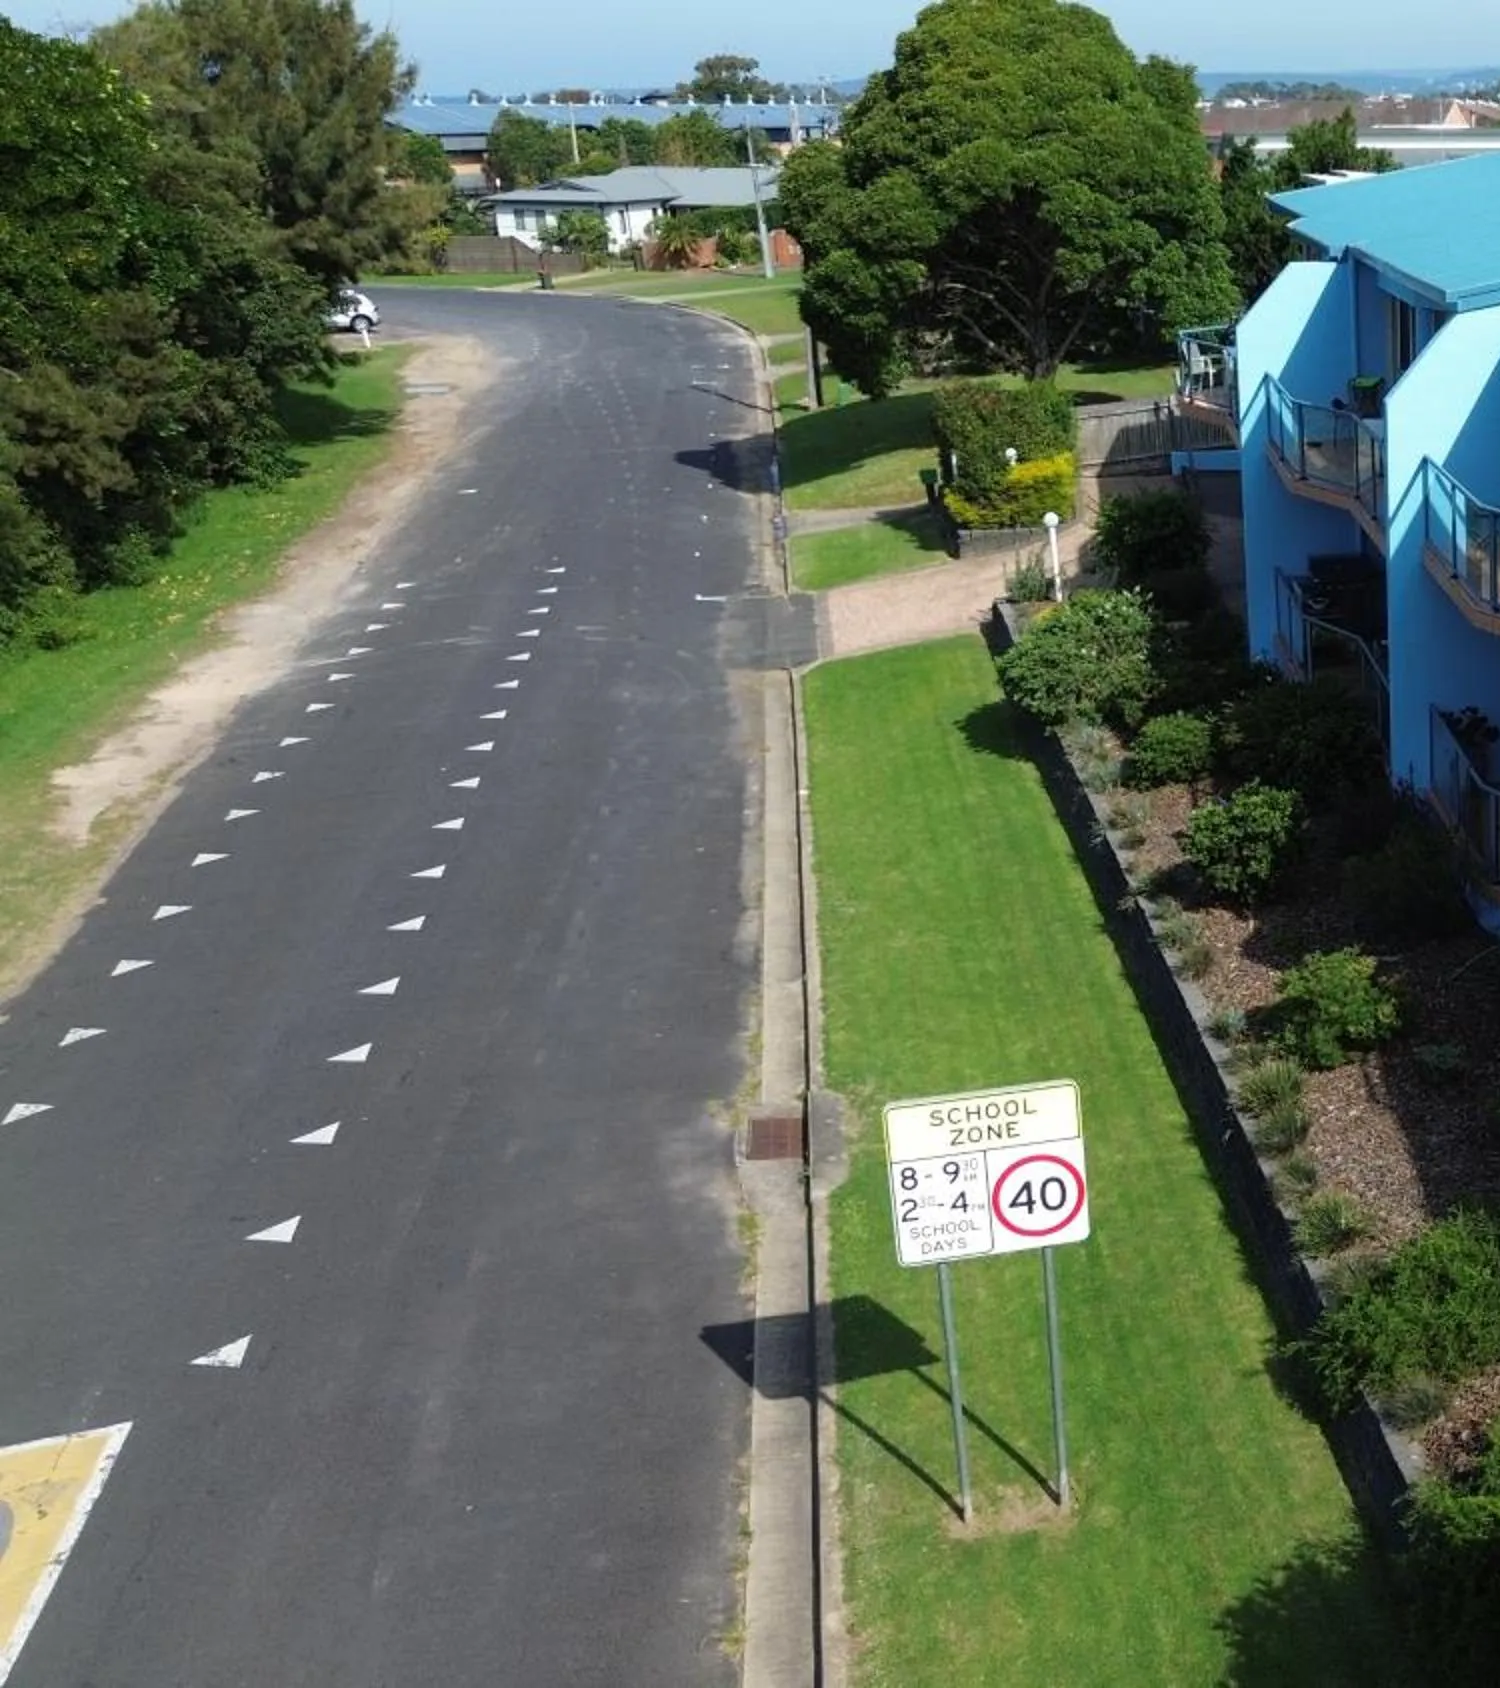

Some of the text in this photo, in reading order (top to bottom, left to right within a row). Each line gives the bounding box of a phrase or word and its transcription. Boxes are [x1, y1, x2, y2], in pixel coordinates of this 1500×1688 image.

[929, 1098, 1038, 1127] SCHOOL
[950, 1121, 1020, 1147] ZONE
[1008, 1176, 1067, 1215] 40
[909, 1219, 982, 1240] SCHOOL
[921, 1237, 967, 1255] DAYS
